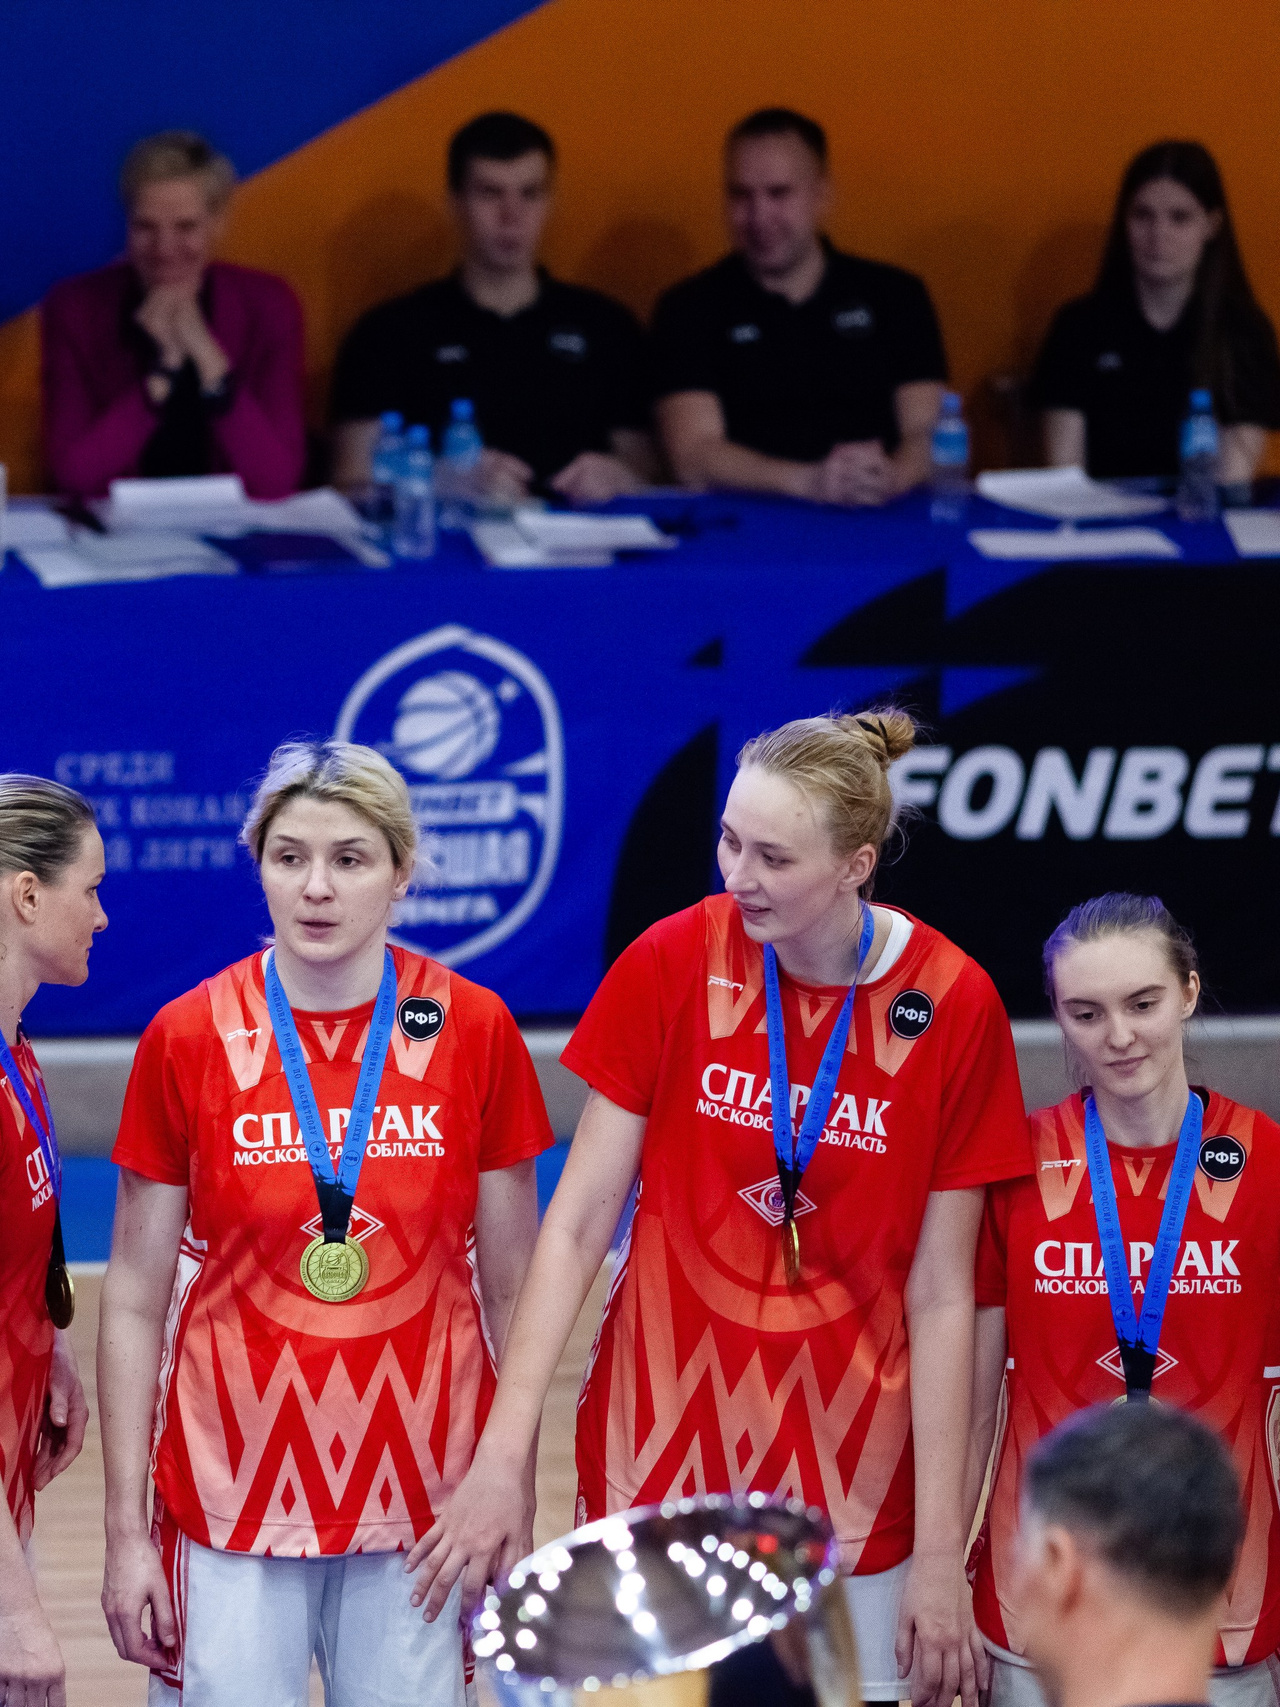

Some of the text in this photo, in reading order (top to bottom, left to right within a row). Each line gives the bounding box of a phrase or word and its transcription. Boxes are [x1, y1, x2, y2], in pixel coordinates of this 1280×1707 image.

[405, 1010, 439, 1024] РФБ
[895, 1004, 928, 1024] РФБ
[701, 1063, 892, 1137] СПАРАК
[818, 1127, 887, 1154] ОБЛАСТЬ
[367, 1142, 445, 1158] ОБЛАСТЬ
[1205, 1151, 1240, 1165] РФБ
[1034, 1239, 1241, 1277] СПРАК
[1167, 1278, 1242, 1295] ОБЛАСТЬ
